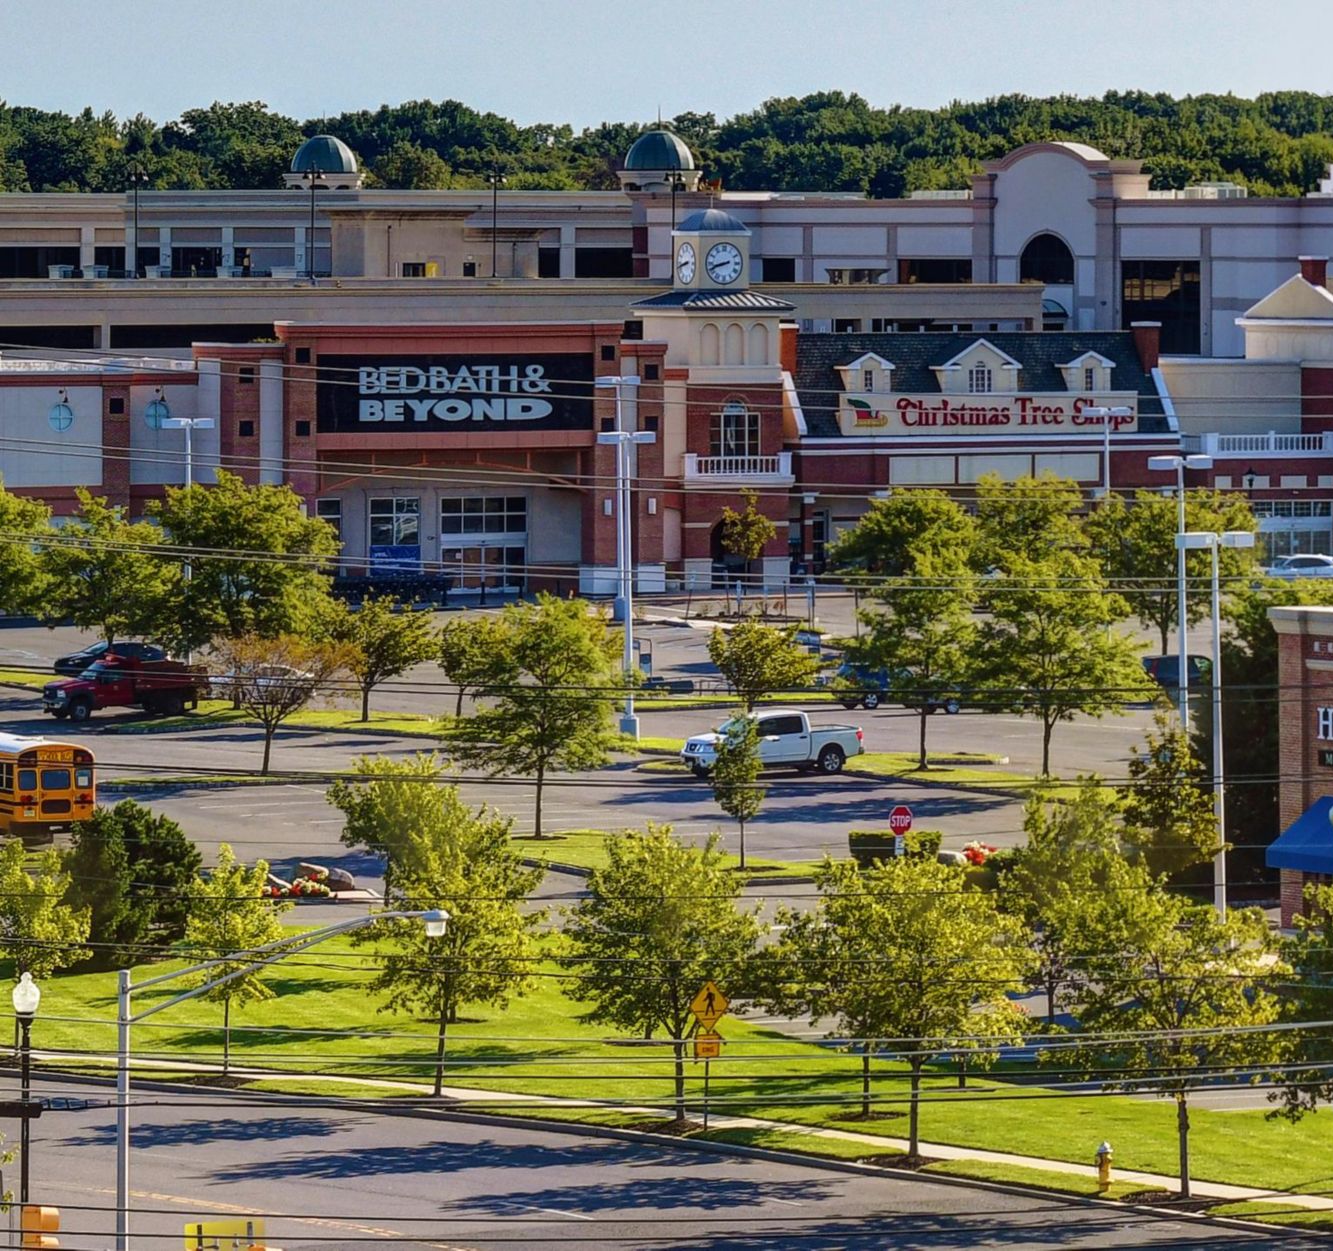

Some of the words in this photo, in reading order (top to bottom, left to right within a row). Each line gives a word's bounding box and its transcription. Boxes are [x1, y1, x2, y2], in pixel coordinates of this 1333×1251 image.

[359, 366, 427, 395] BED
[429, 365, 519, 394] BATH
[521, 364, 553, 393] &
[359, 398, 553, 422] BEYOND
[896, 397, 1011, 427] Christmas
[1014, 397, 1065, 427] Tree
[891, 815, 911, 828] STOP
